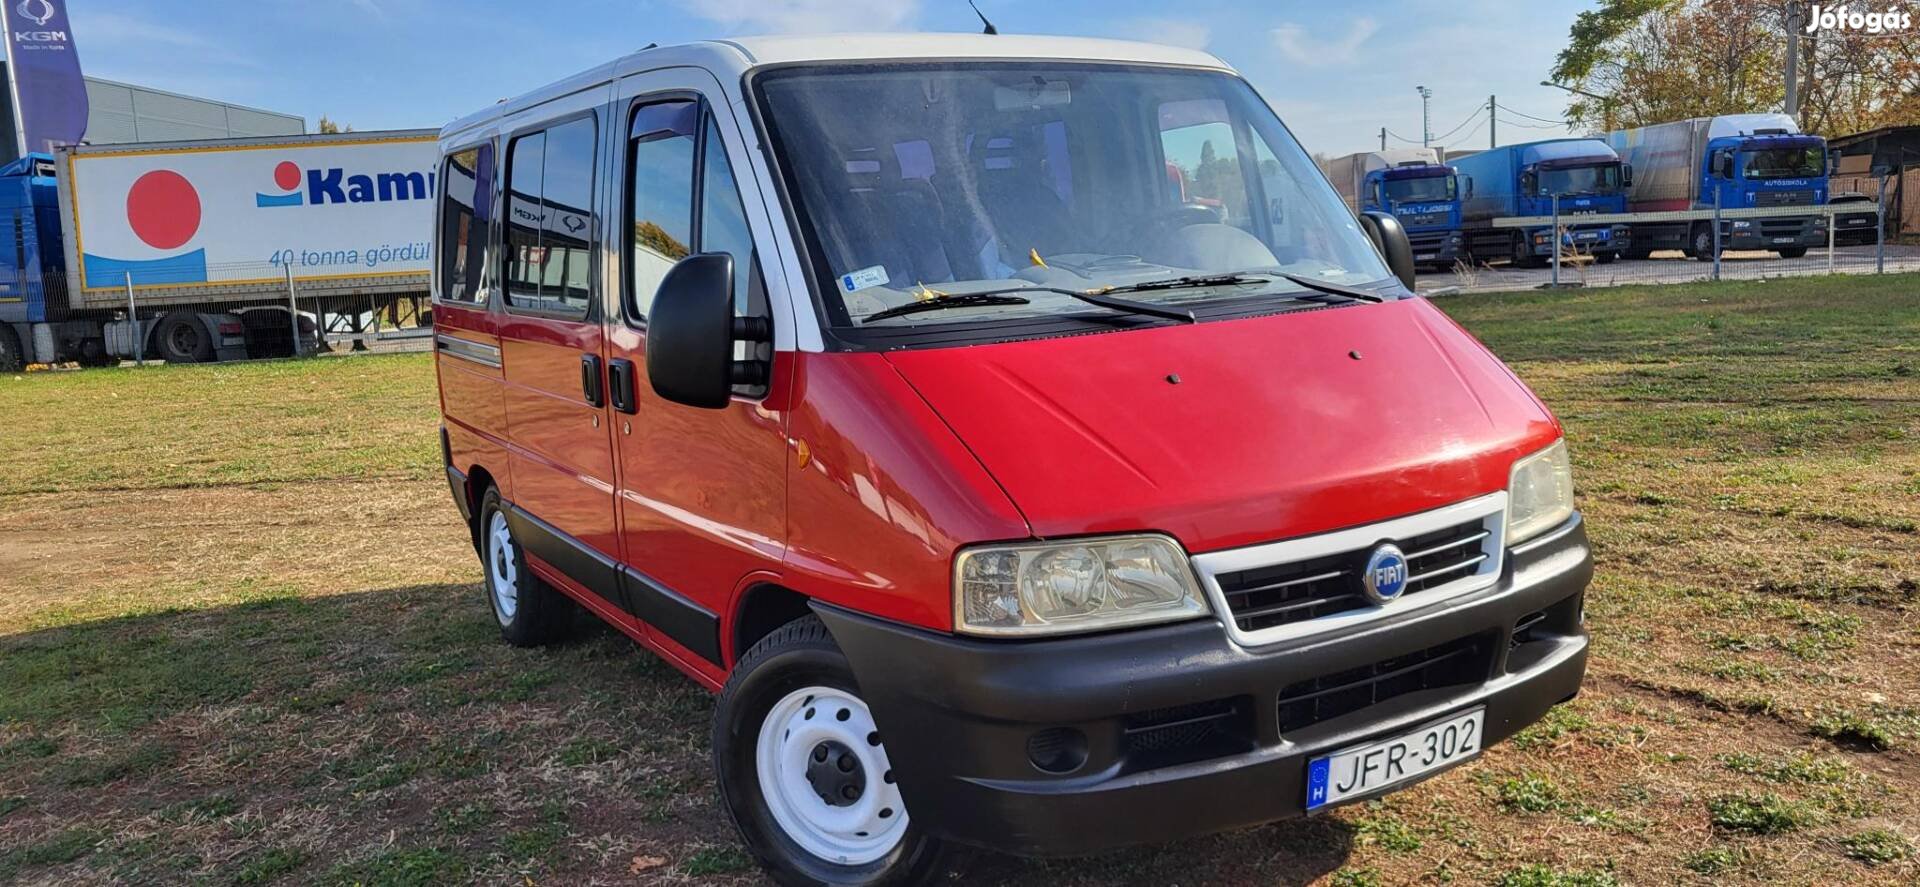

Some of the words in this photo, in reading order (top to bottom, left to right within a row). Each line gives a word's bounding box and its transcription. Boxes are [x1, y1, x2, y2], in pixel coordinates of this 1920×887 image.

[15, 31, 67, 41] KGM
[269, 249, 294, 267] 40
[301, 250, 358, 266] tonna
[365, 242, 431, 267] gördül
[1375, 563, 1403, 587] FIAT
[1336, 718, 1476, 793] JFR-302
[1313, 786, 1323, 800] H
